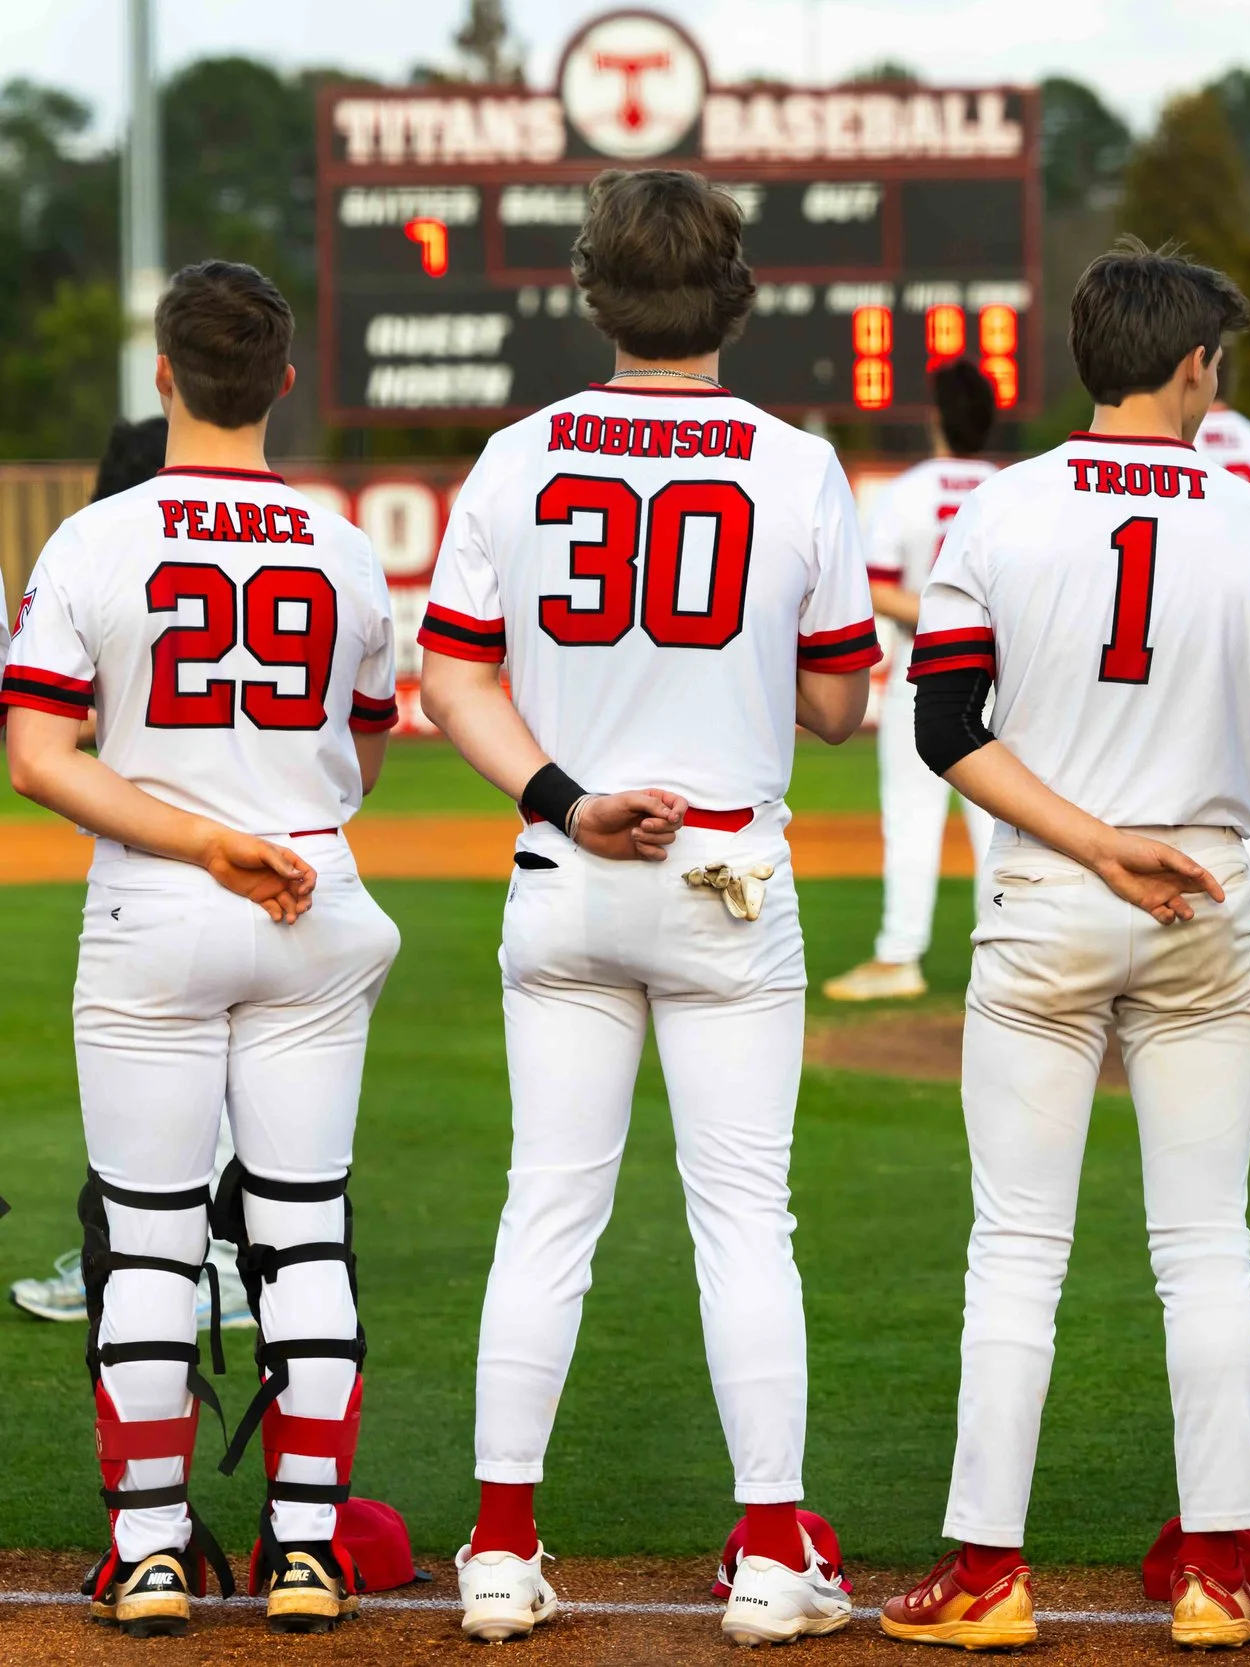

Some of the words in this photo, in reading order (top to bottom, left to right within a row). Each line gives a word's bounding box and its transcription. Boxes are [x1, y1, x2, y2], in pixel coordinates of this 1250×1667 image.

[335, 97, 566, 165] TITANS
[701, 93, 1022, 160] BASEBALL
[548, 411, 756, 461] ROBINSON
[1068, 459, 1208, 499] TROUT
[158, 500, 314, 545] PEARCE
[536, 473, 754, 650] 30
[1098, 516, 1158, 685] 1
[145, 561, 337, 732] 29
[147, 1571, 175, 1586] NIKE
[283, 1569, 311, 1582] NIKE
[475, 1592, 511, 1600] DIAMOND
[735, 1595, 769, 1607] DIAMOND
